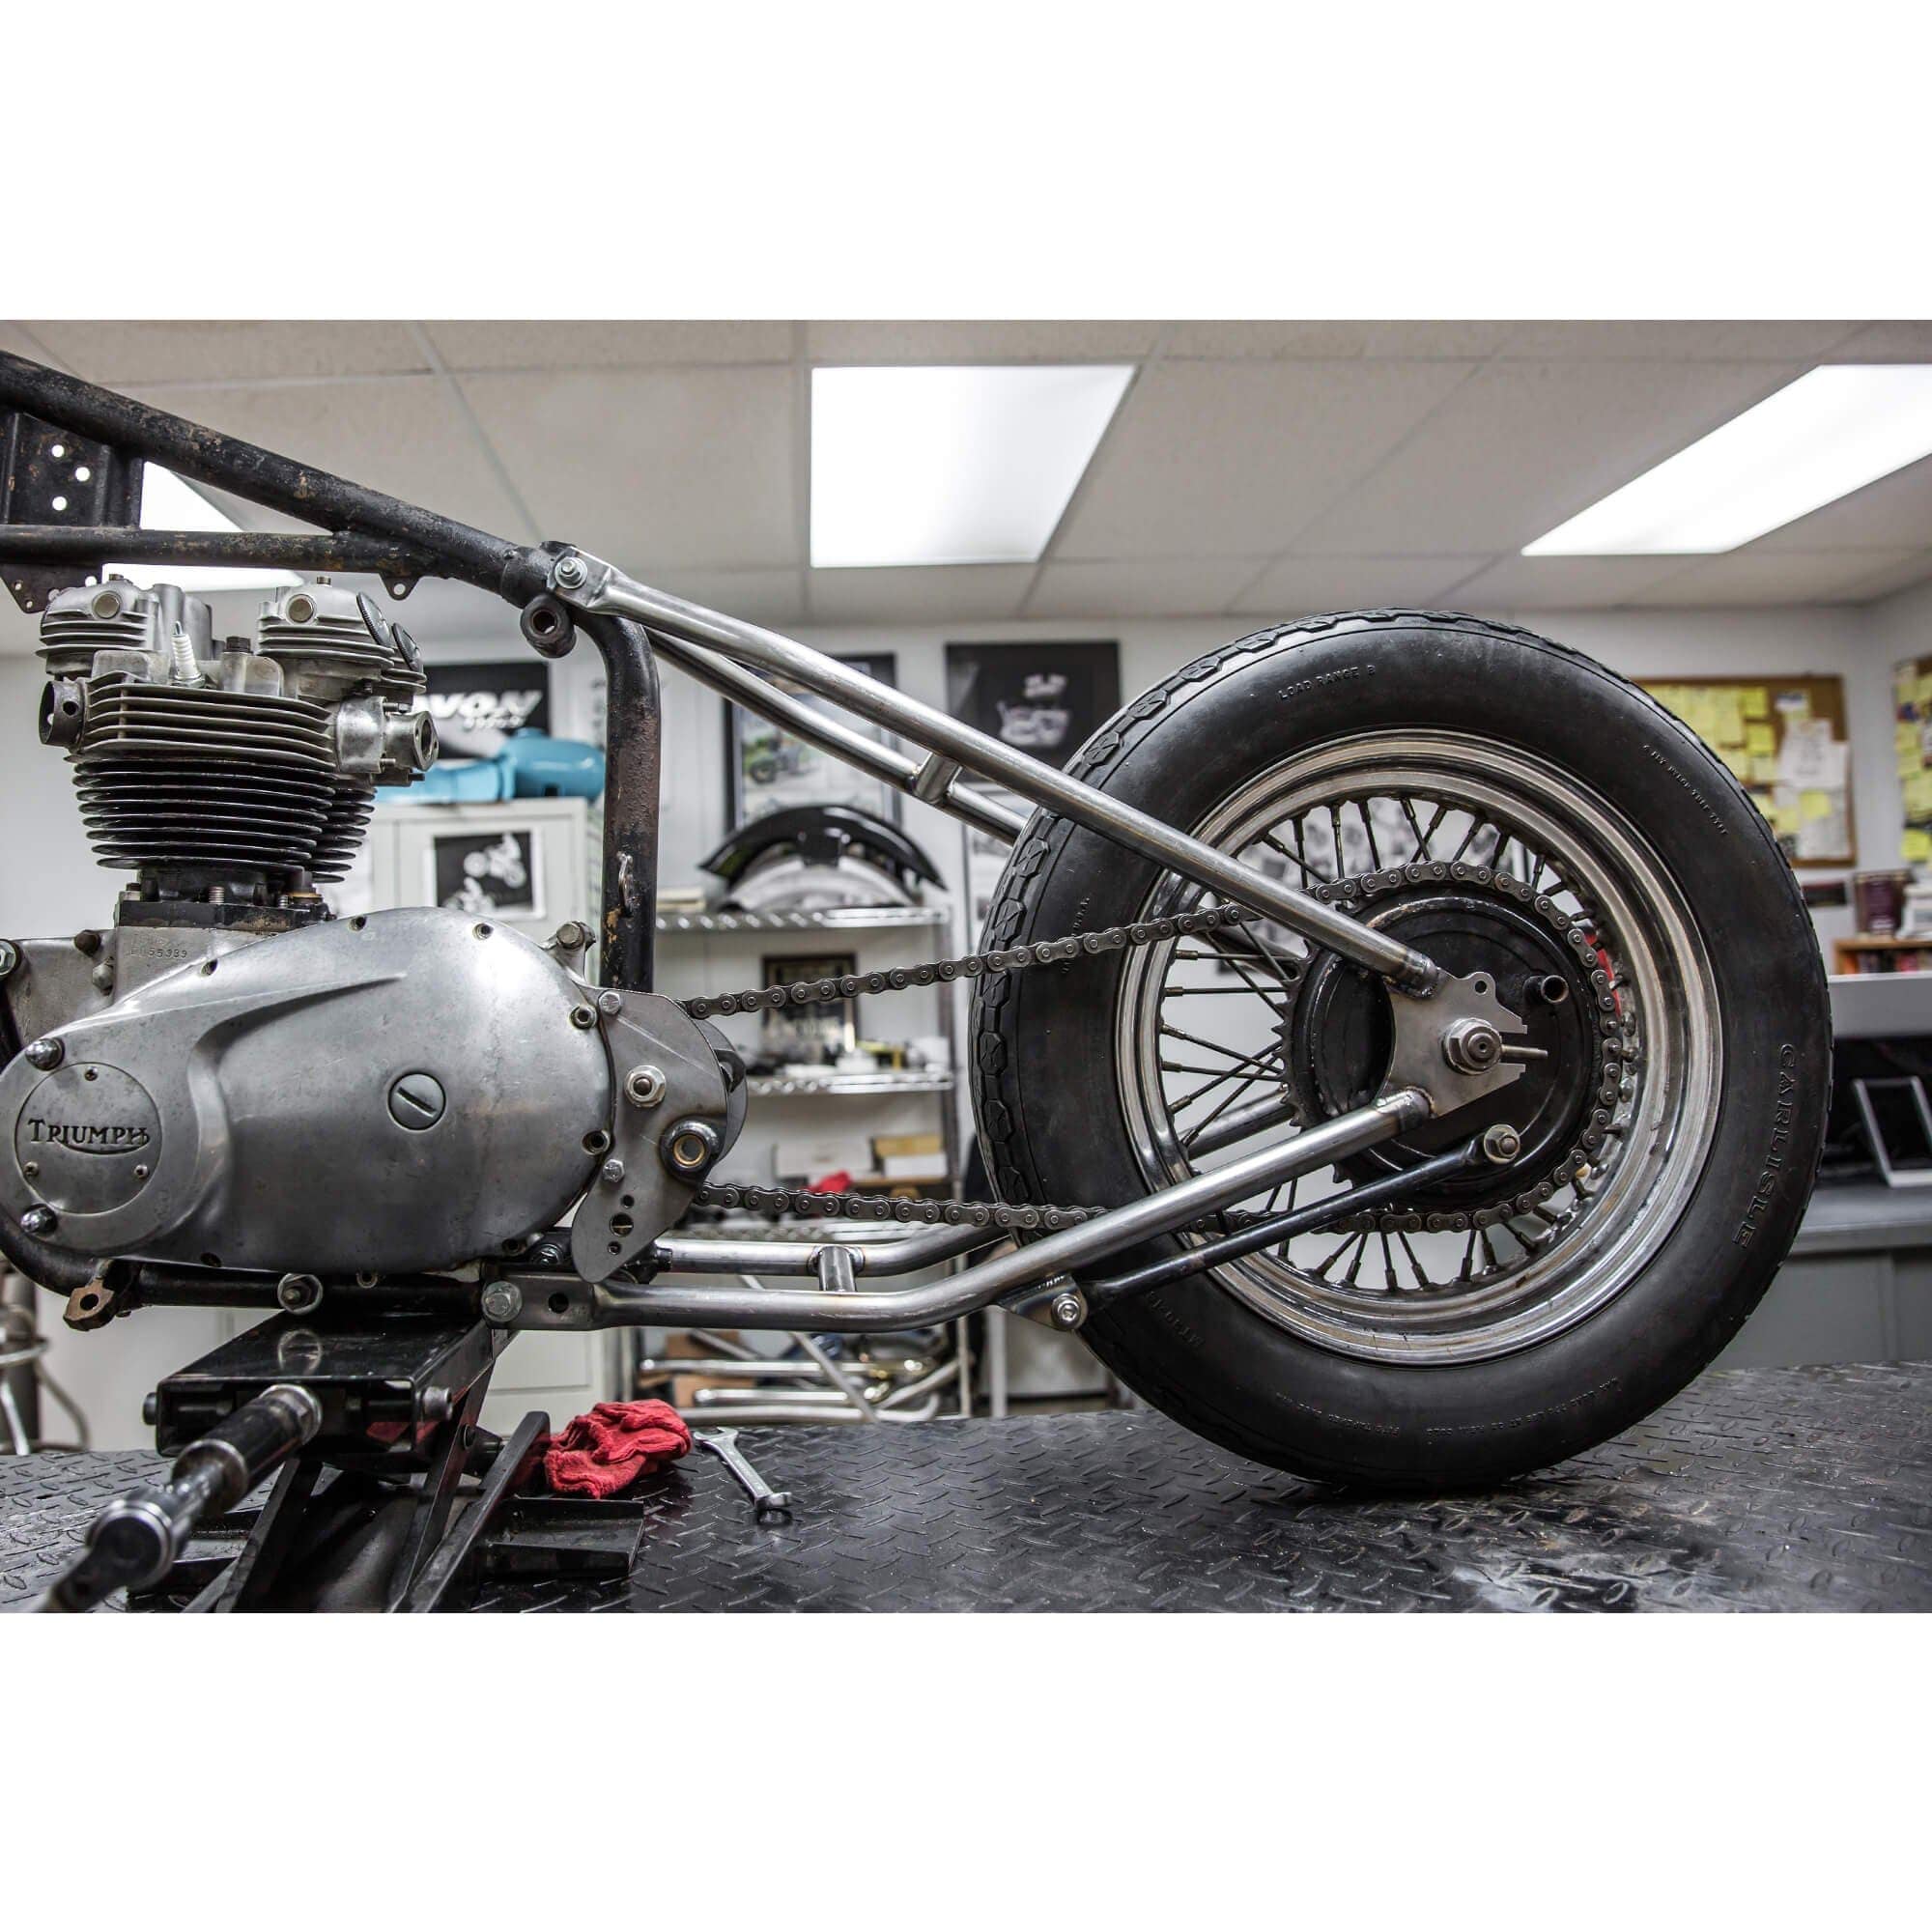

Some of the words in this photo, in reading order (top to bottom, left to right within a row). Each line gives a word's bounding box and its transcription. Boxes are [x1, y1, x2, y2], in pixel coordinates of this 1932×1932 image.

[1276, 679, 1313, 703] LOAD
[1315, 667, 1360, 687] RANGE
[413, 690, 542, 719] VON
[27, 1118, 151, 1154] TRIUMPH
[1733, 1043, 1795, 1247] CARLISLE
